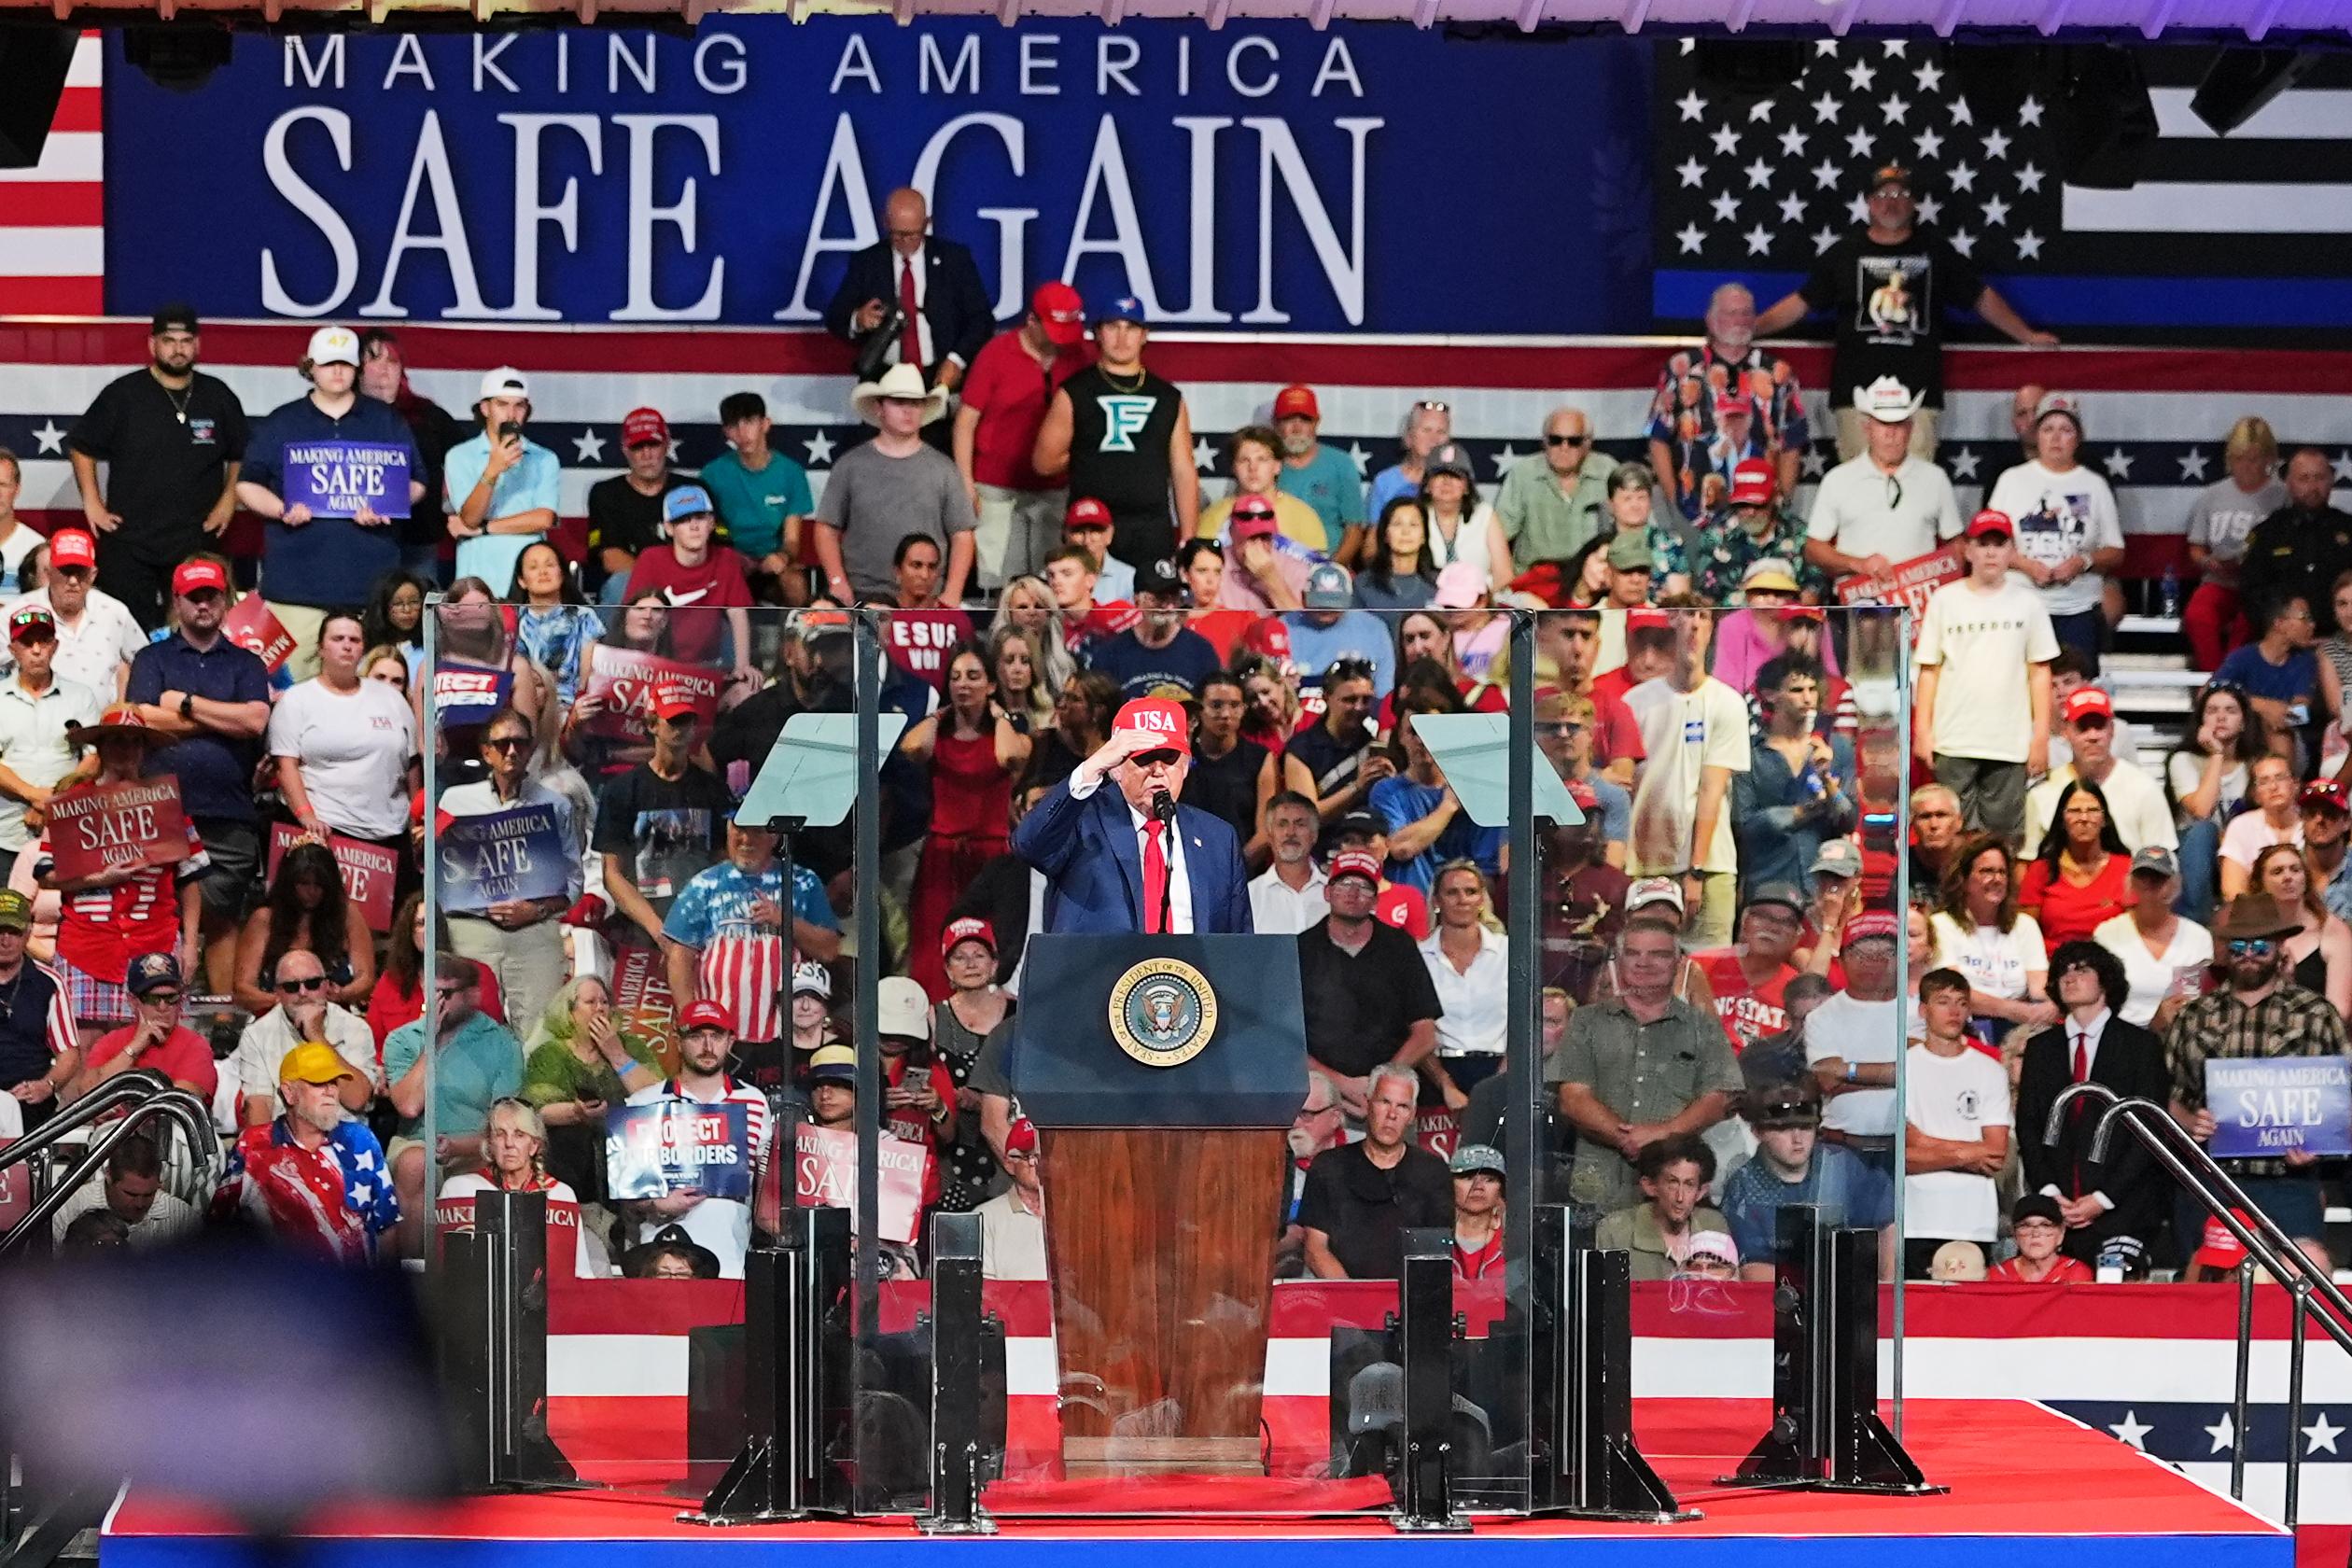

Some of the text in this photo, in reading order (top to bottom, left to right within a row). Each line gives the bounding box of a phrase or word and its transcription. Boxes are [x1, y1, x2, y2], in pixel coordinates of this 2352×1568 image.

[285, 34, 1364, 98] MAKING AMERICA
[261, 105, 1385, 327] SAFE AGAIN
[289, 447, 407, 468] MAKING AMERICA
[311, 464, 385, 497] SAFE
[328, 496, 369, 511] AGAIN
[2209, 511, 2268, 545] US
[892, 621, 957, 649] ESUS
[609, 679, 655, 718] SA
[1133, 710, 1177, 732] USA
[51, 784, 176, 820] MAKING AMERICA
[77, 805, 159, 850] SAFE
[490, 815, 551, 841] AMERICA
[101, 842, 144, 866] AGAIN
[441, 836, 533, 885] SAFE
[1113, 962, 1160, 1010] PRESIDENT
[1190, 974, 1213, 1018] UNITED
[1736, 998, 1786, 1029] STAT
[1127, 1043, 1155, 1061] SEAL
[1172, 1029, 1209, 1061] STATES
[2278, 1067, 2346, 1085] AMERICA
[1420, 1113, 1454, 1132] AKIN
[2239, 1087, 2323, 1127] SAFE
[778, 1136, 845, 1160] AKING
[2258, 1128, 2306, 1147] AGAIN
